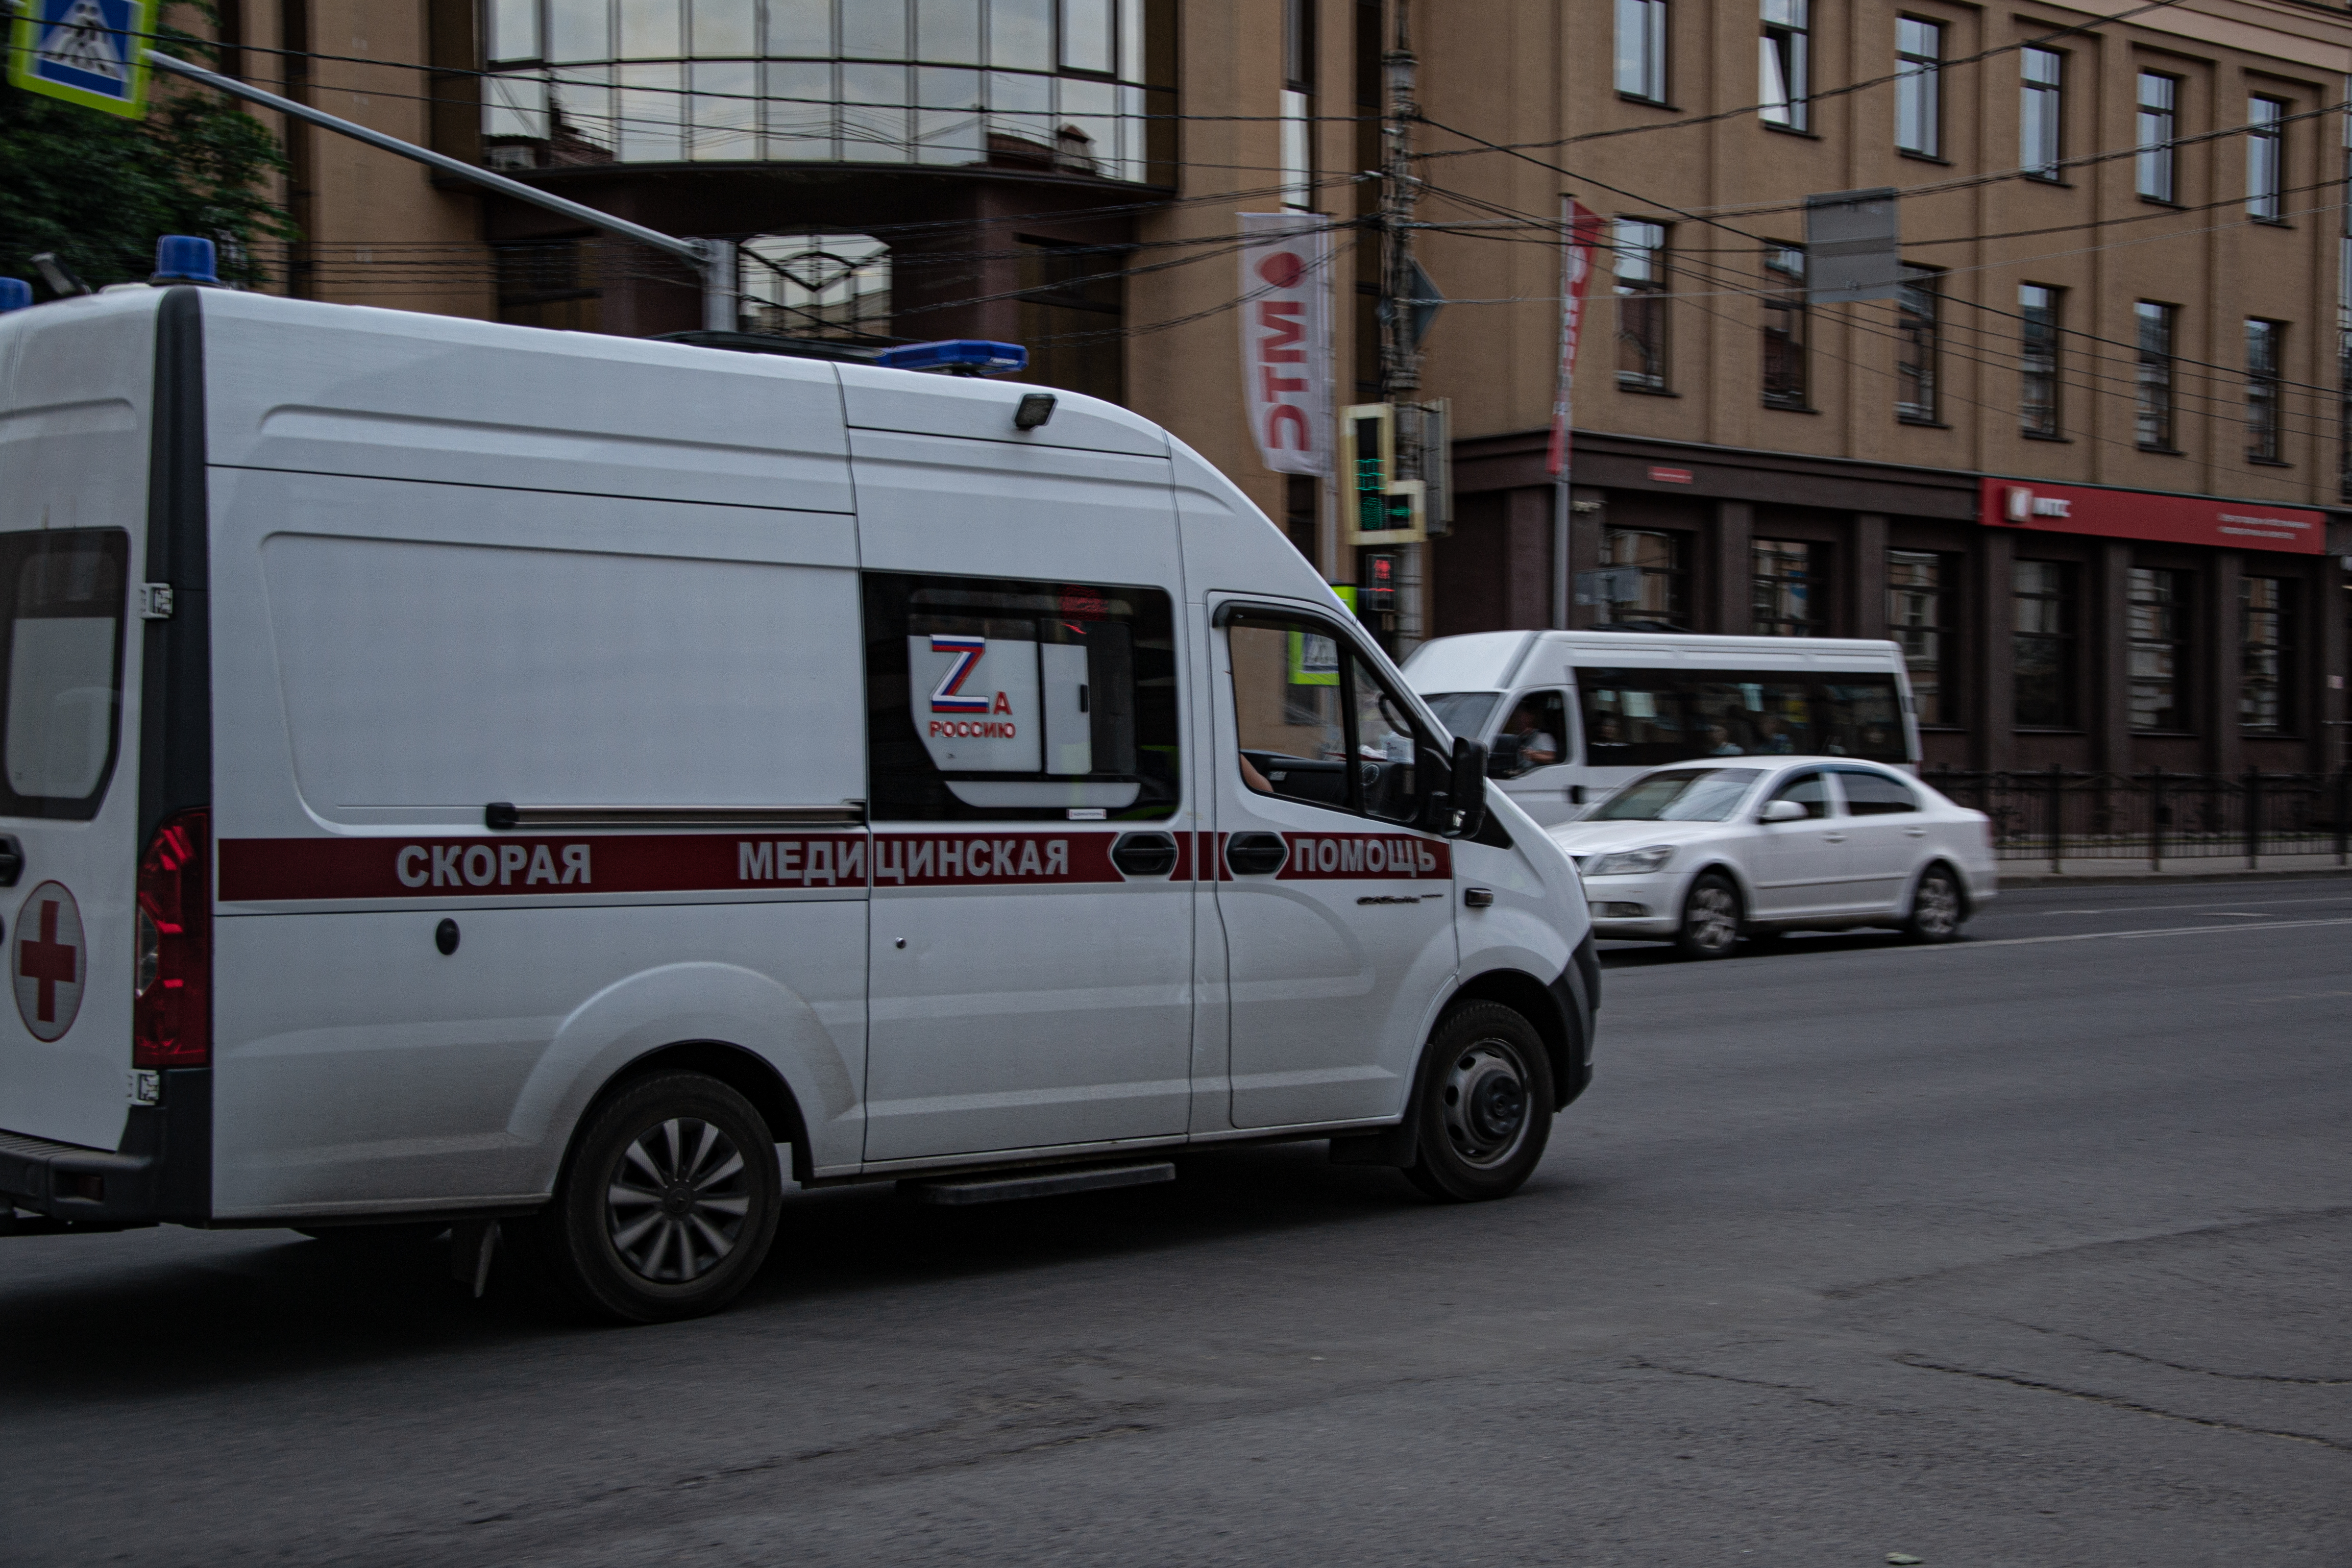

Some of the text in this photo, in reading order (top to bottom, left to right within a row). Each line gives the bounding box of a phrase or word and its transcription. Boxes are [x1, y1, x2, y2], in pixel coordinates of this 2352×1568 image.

[929, 721, 1016, 739] РОССИЮ
[395, 839, 1436, 888] СКОРАЯ МЕДИЦИНСКАЯ ПОМОЩЬ
